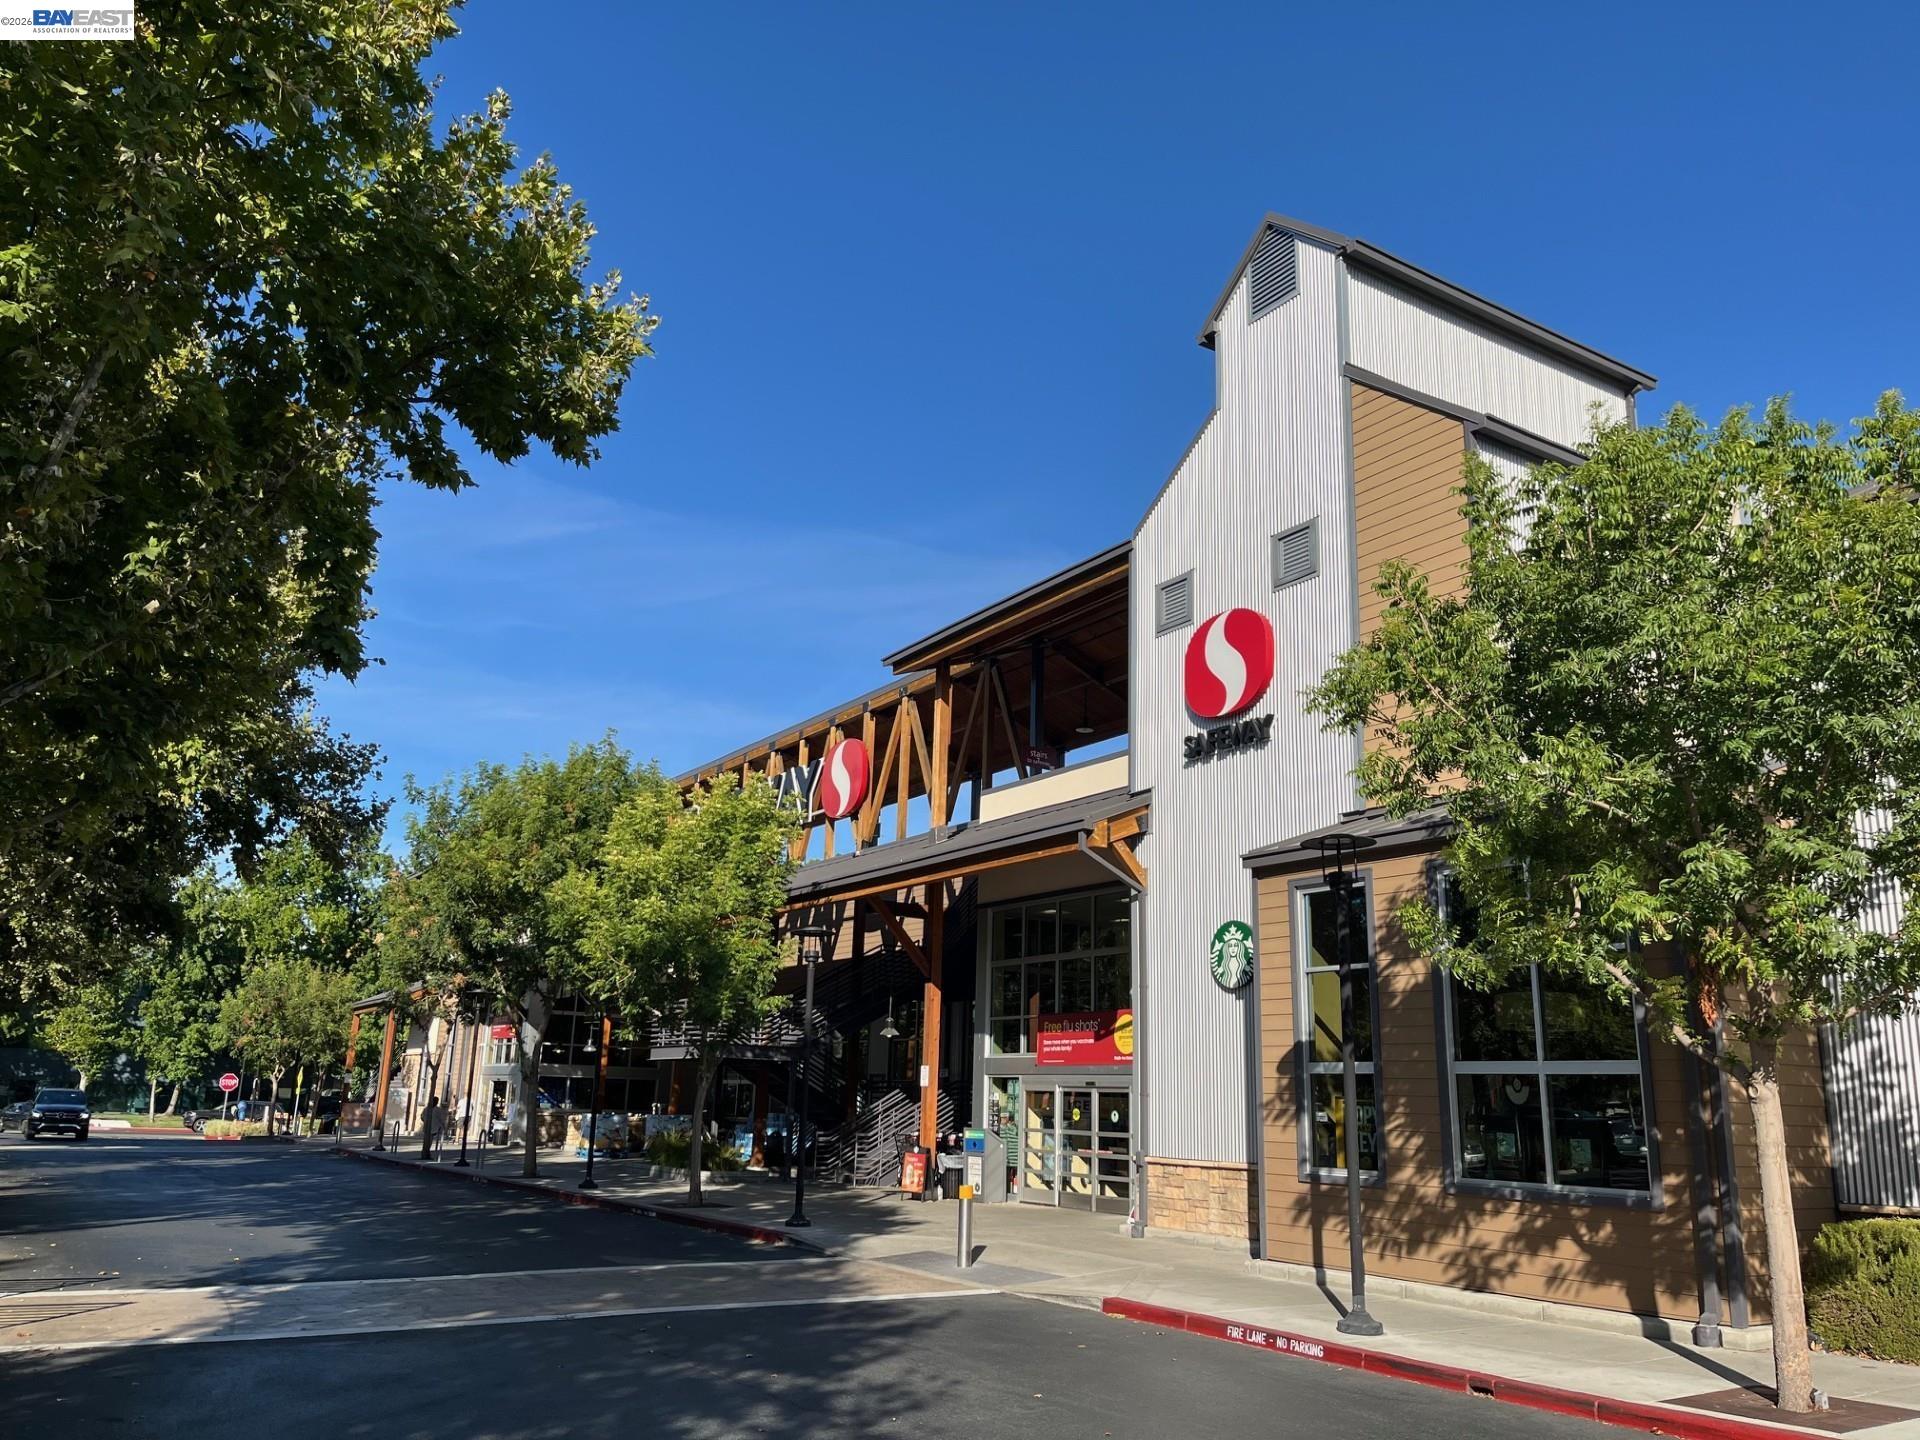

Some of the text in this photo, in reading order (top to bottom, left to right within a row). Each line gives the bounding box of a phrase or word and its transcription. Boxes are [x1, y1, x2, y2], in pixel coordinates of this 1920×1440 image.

[1184, 714, 1275, 759] SAFEWAY
[1043, 1022, 1062, 1032] Free
[1063, 1019, 1074, 1032] flu
[1227, 1325, 1244, 1339] FIRE
[1246, 1329, 1267, 1345] LANE
[1276, 1336, 1287, 1349] NO
[1290, 1340, 1324, 1357] PARKING
